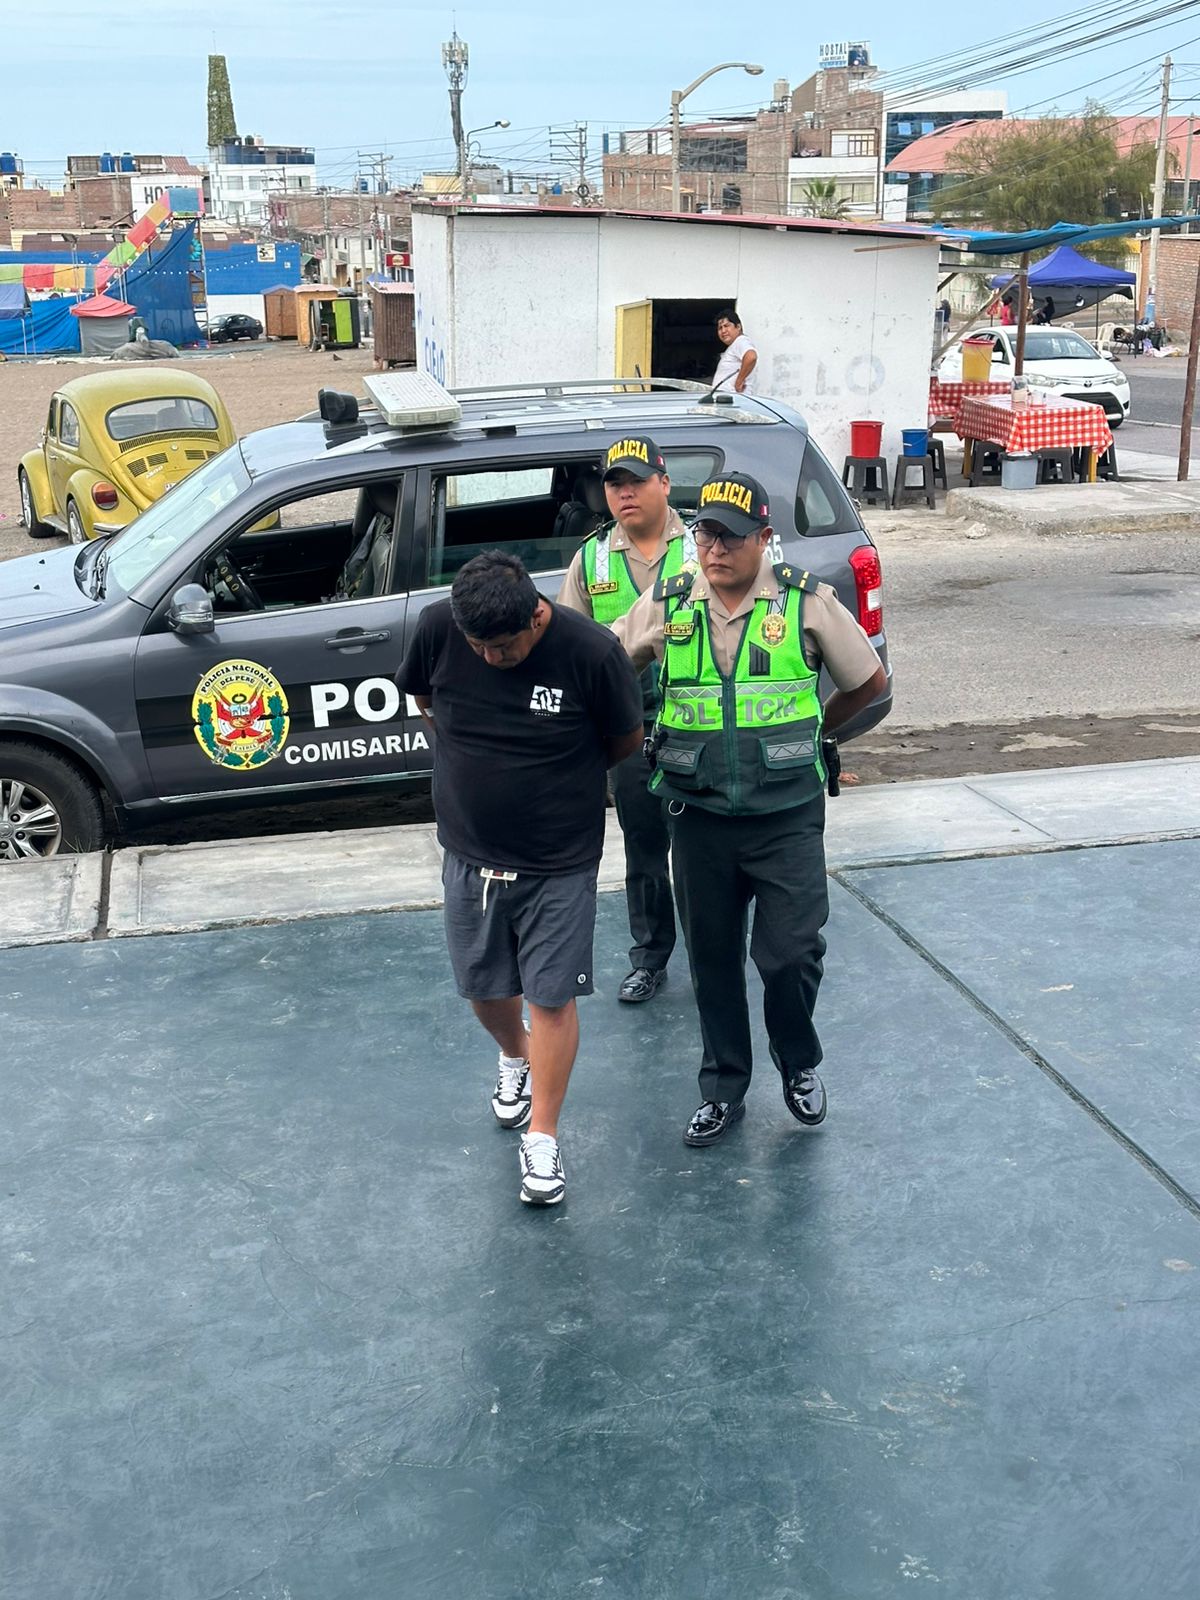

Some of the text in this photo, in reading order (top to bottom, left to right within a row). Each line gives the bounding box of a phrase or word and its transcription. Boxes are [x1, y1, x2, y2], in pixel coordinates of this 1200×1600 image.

[819, 42, 847, 57] HOSTAL
[607, 439, 649, 468] POLICIA
[700, 481, 752, 513] POLICIA
[201, 664, 274, 693] POLICIA NACIONAL
[220, 676, 235, 686] DEL
[284, 731, 430, 765] COMISARIA
